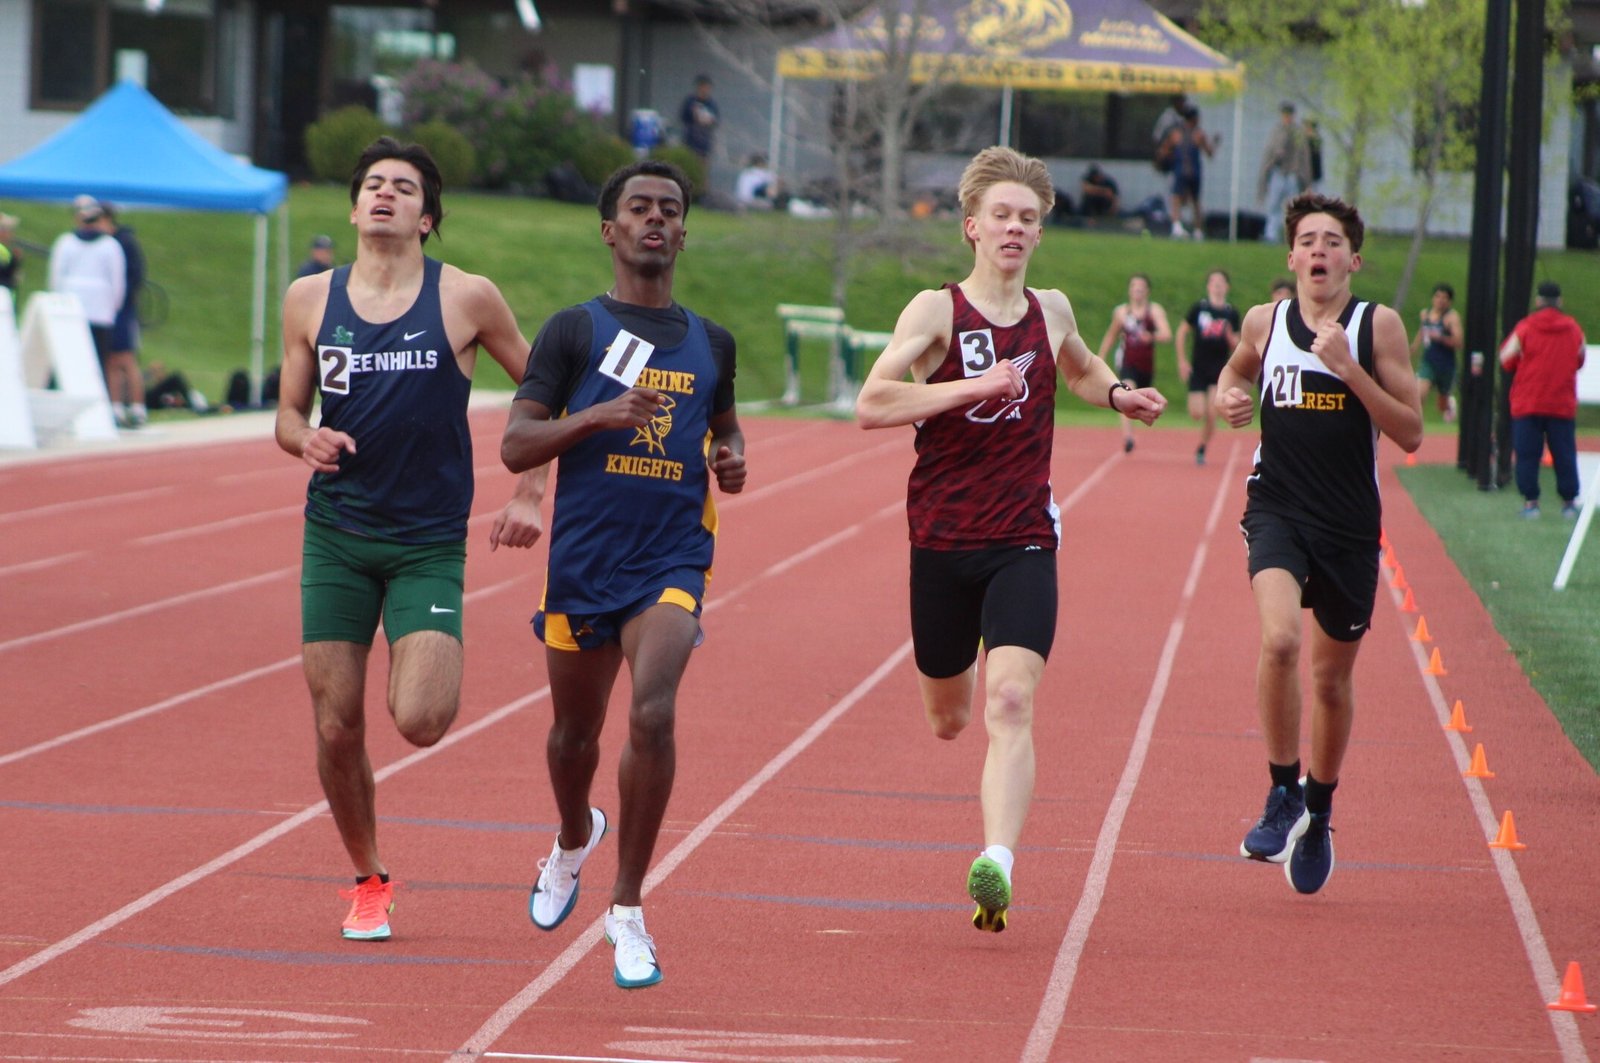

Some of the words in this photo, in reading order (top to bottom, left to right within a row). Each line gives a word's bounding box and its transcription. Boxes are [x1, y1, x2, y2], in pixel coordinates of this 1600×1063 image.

[350, 350, 438, 373] EENHILLS
[962, 331, 994, 371] 3
[321, 348, 348, 390] 2
[634, 367, 695, 395] HRINE
[1273, 364, 1300, 402] 27
[604, 453, 684, 481] KNIGHTS
